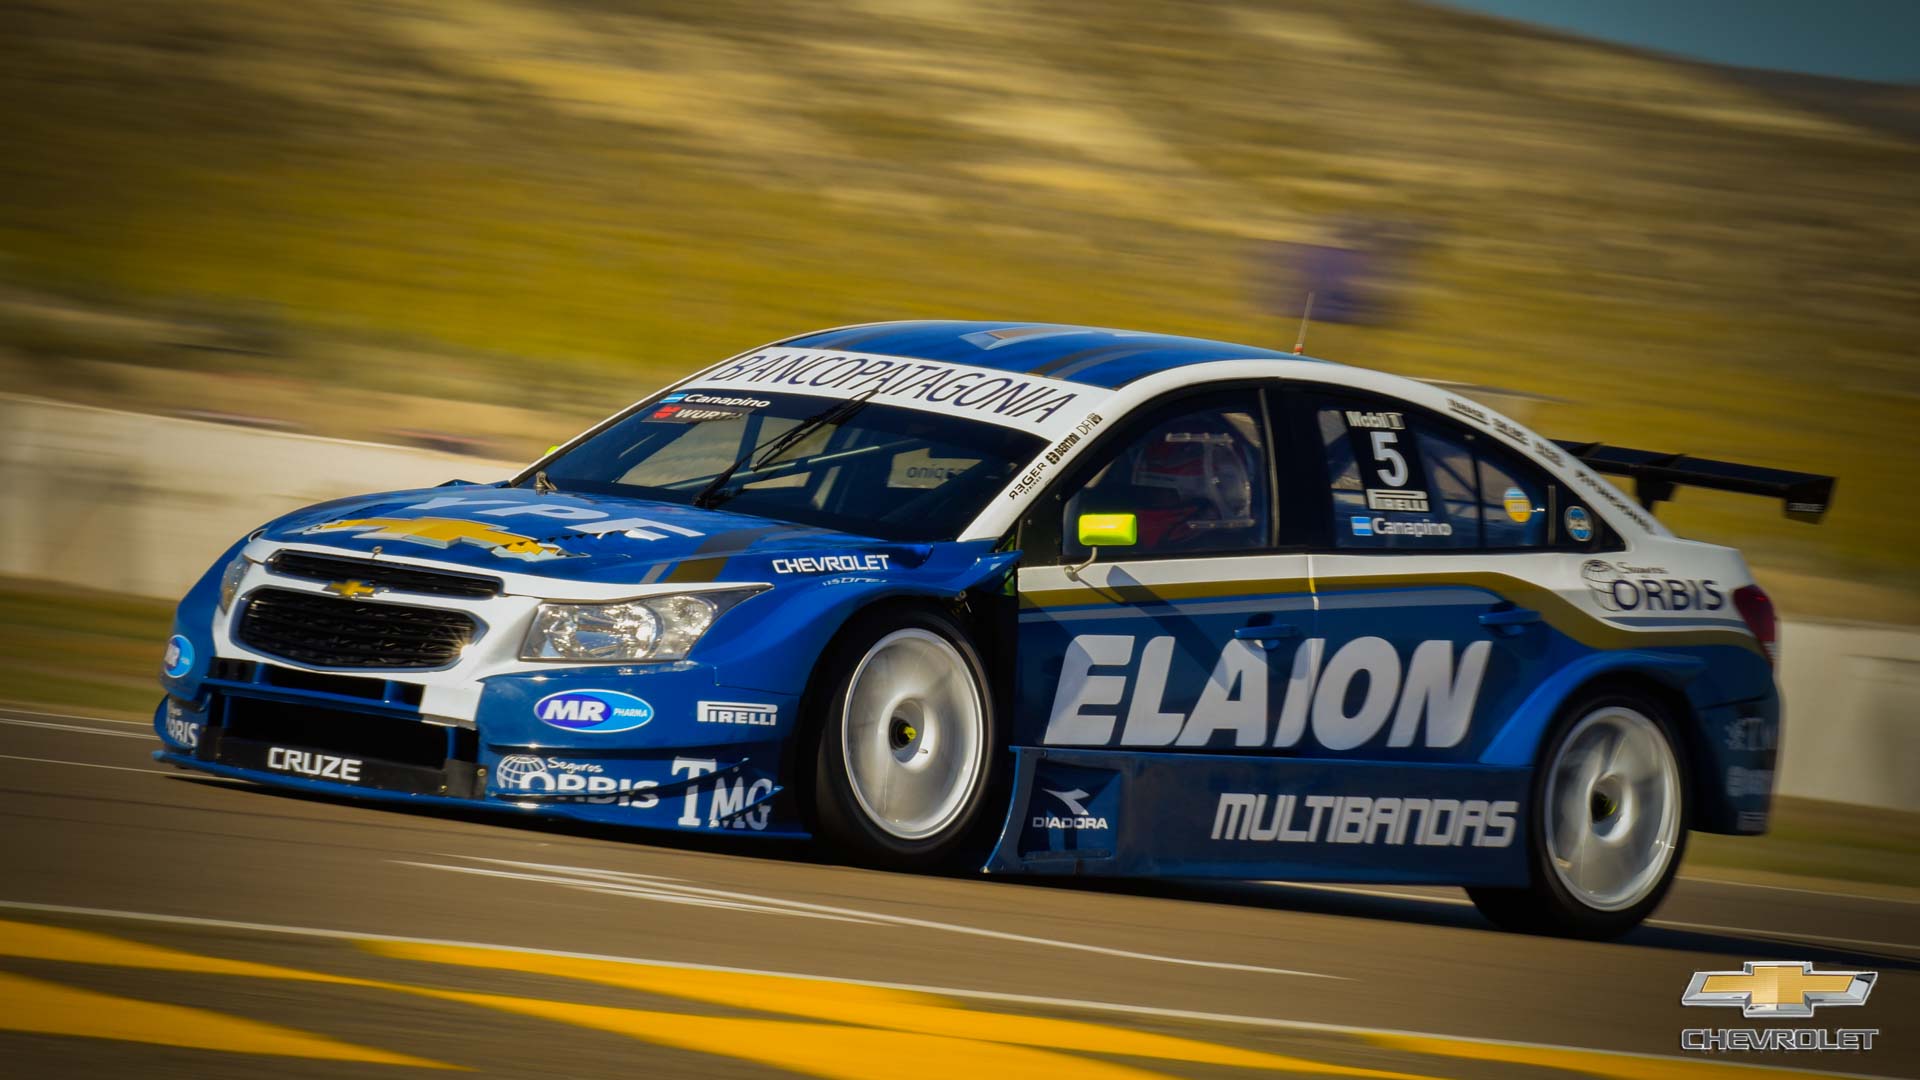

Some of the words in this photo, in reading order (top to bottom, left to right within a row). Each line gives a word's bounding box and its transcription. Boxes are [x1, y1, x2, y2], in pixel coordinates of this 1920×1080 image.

[684, 394, 771, 408] Canapino
[707, 354, 1079, 424] BANCOPATAGONIA
[1369, 431, 1409, 488] 5
[1371, 517, 1453, 538] Canapino
[772, 554, 890, 574] CHEVROLET
[1613, 579, 1722, 612] ORBIS
[1044, 634, 1494, 751] ELAION
[542, 699, 606, 722] MR
[612, 707, 649, 718] PHARMA
[697, 700, 778, 726] PIRELLI
[267, 747, 363, 782] CRUZE
[547, 757, 604, 774] Seguros
[672, 755, 774, 831] TMG
[1033, 816, 1109, 831] DIADORA
[1211, 792, 1519, 848] MULTIBANDAS
